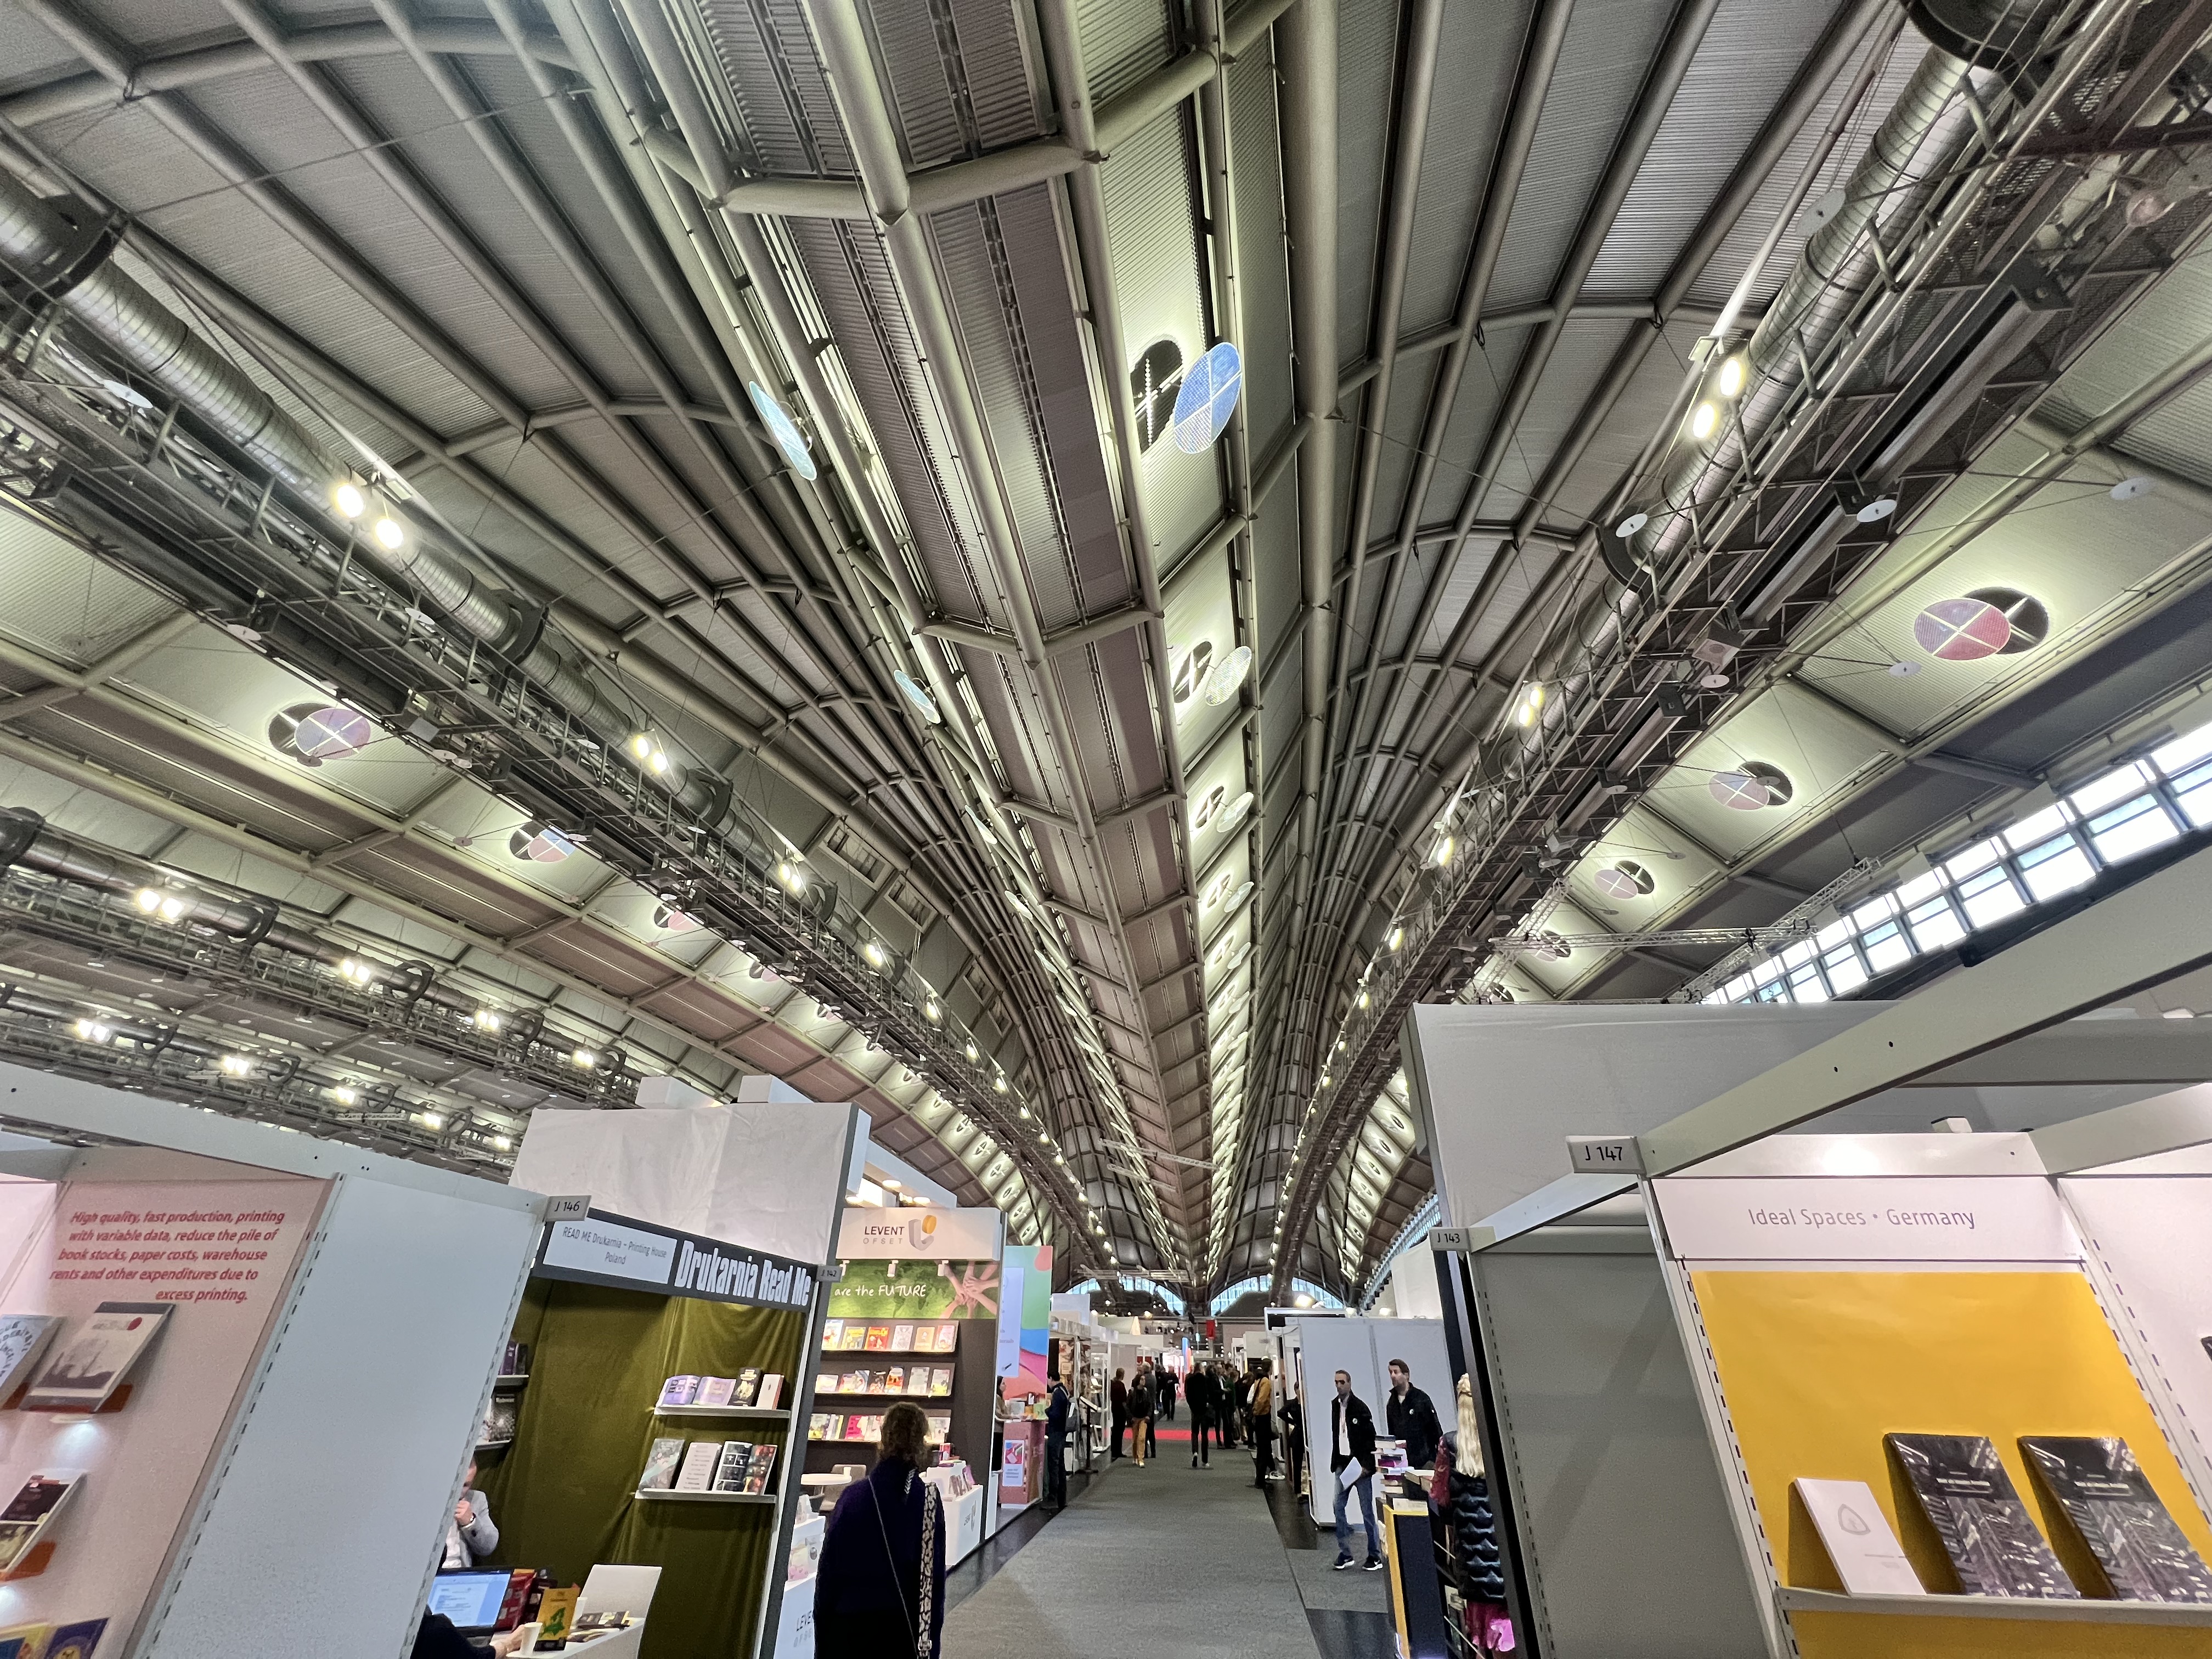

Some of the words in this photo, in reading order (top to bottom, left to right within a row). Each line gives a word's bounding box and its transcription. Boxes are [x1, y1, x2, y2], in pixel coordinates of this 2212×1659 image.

[1585, 1145, 1591, 1161] J
[1596, 1146, 1622, 1161] 147
[554, 1201, 560, 1211] J
[563, 1201, 580, 1211] 146
[70, 1211, 98, 1225] High
[99, 1210, 140, 1225] quality,
[143, 1210, 166, 1223] fast
[165, 1210, 234, 1224] production,
[234, 1210, 285, 1224] printing
[1748, 1209, 1796, 1225] Ideal
[1801, 1209, 1866, 1229] Spaces
[1886, 1209, 1974, 1229] Germany
[69, 1229, 94, 1241] with
[96, 1229, 142, 1241] variable
[143, 1229, 171, 1243] data,
[174, 1229, 215, 1241] reduce
[217, 1229, 238, 1241] the
[236, 1228, 262, 1244] pile
[263, 1228, 280, 1241] of
[864, 1226, 905, 1235] LEVENT
[1437, 1232, 1441, 1243] J
[1444, 1233, 1460, 1243] 143
[562, 1226, 580, 1239] READ
[581, 1231, 592, 1242] ME
[628, 1241, 650, 1257] Printing
[651, 1248, 668, 1258] House
[59, 1248, 88, 1260] book
[89, 1248, 127, 1261] stocks,
[128, 1251, 166, 1263] paper
[167, 1249, 199, 1262] costs,
[202, 1248, 267, 1260] warehouse
[605, 1251, 627, 1265] Poland
[49, 1269, 81, 1279] rents
[81, 1267, 106, 1279] and
[106, 1267, 139, 1279] other
[139, 1267, 218, 1283] expenditures
[219, 1268, 244, 1280] due
[245, 1268, 259, 1280] to
[674, 1240, 759, 1298] Drukarnia
[758, 1259, 794, 1304] Read
[791, 1267, 811, 1306] Me
[155, 1290, 195, 1300] excess
[194, 1288, 248, 1304] printing.
[834, 1287, 851, 1296] are
[855, 1285, 874, 1296] the
[878, 1284, 927, 1297] FUTURE
